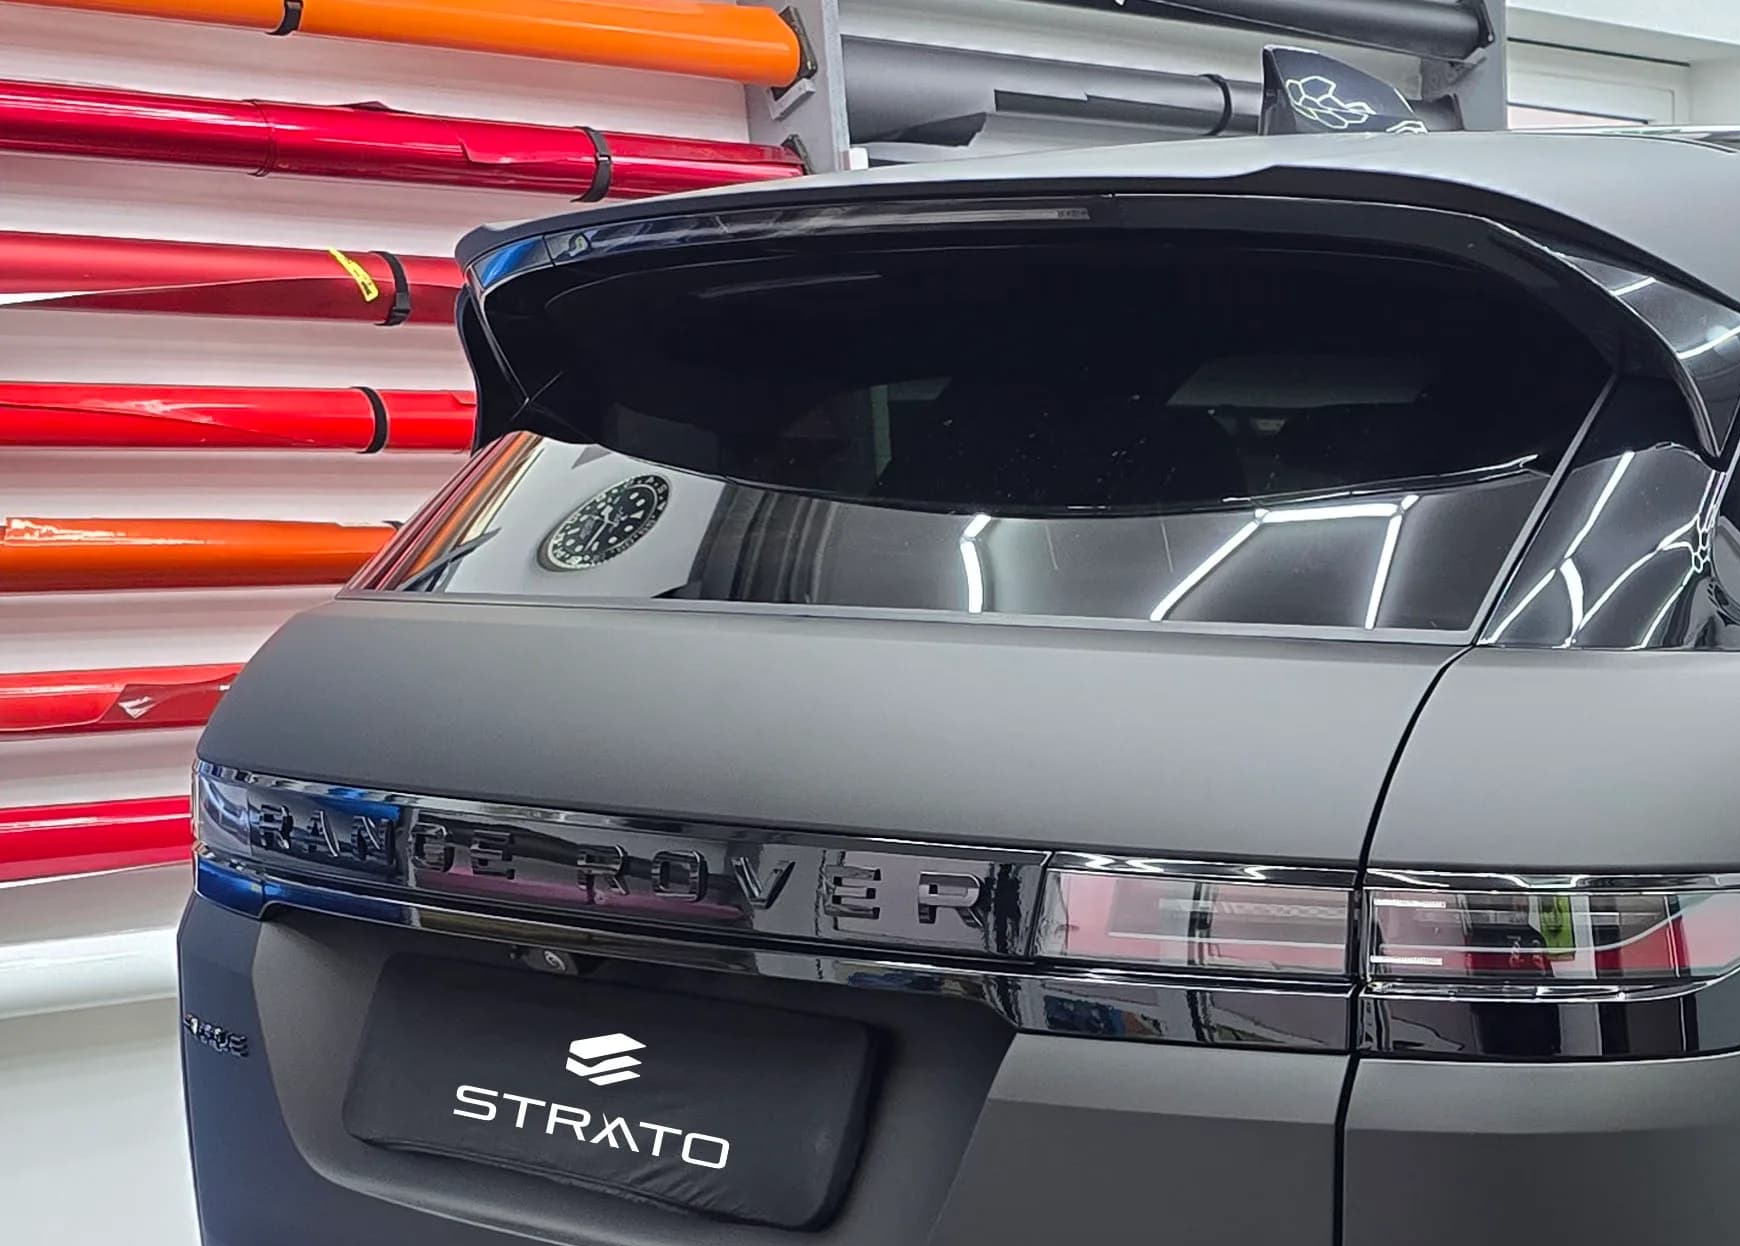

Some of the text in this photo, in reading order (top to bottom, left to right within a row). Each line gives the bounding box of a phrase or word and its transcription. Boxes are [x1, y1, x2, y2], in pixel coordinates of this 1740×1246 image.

[258, 803, 984, 929] RANGE ROVER
[453, 1084, 729, 1169] STRATO
